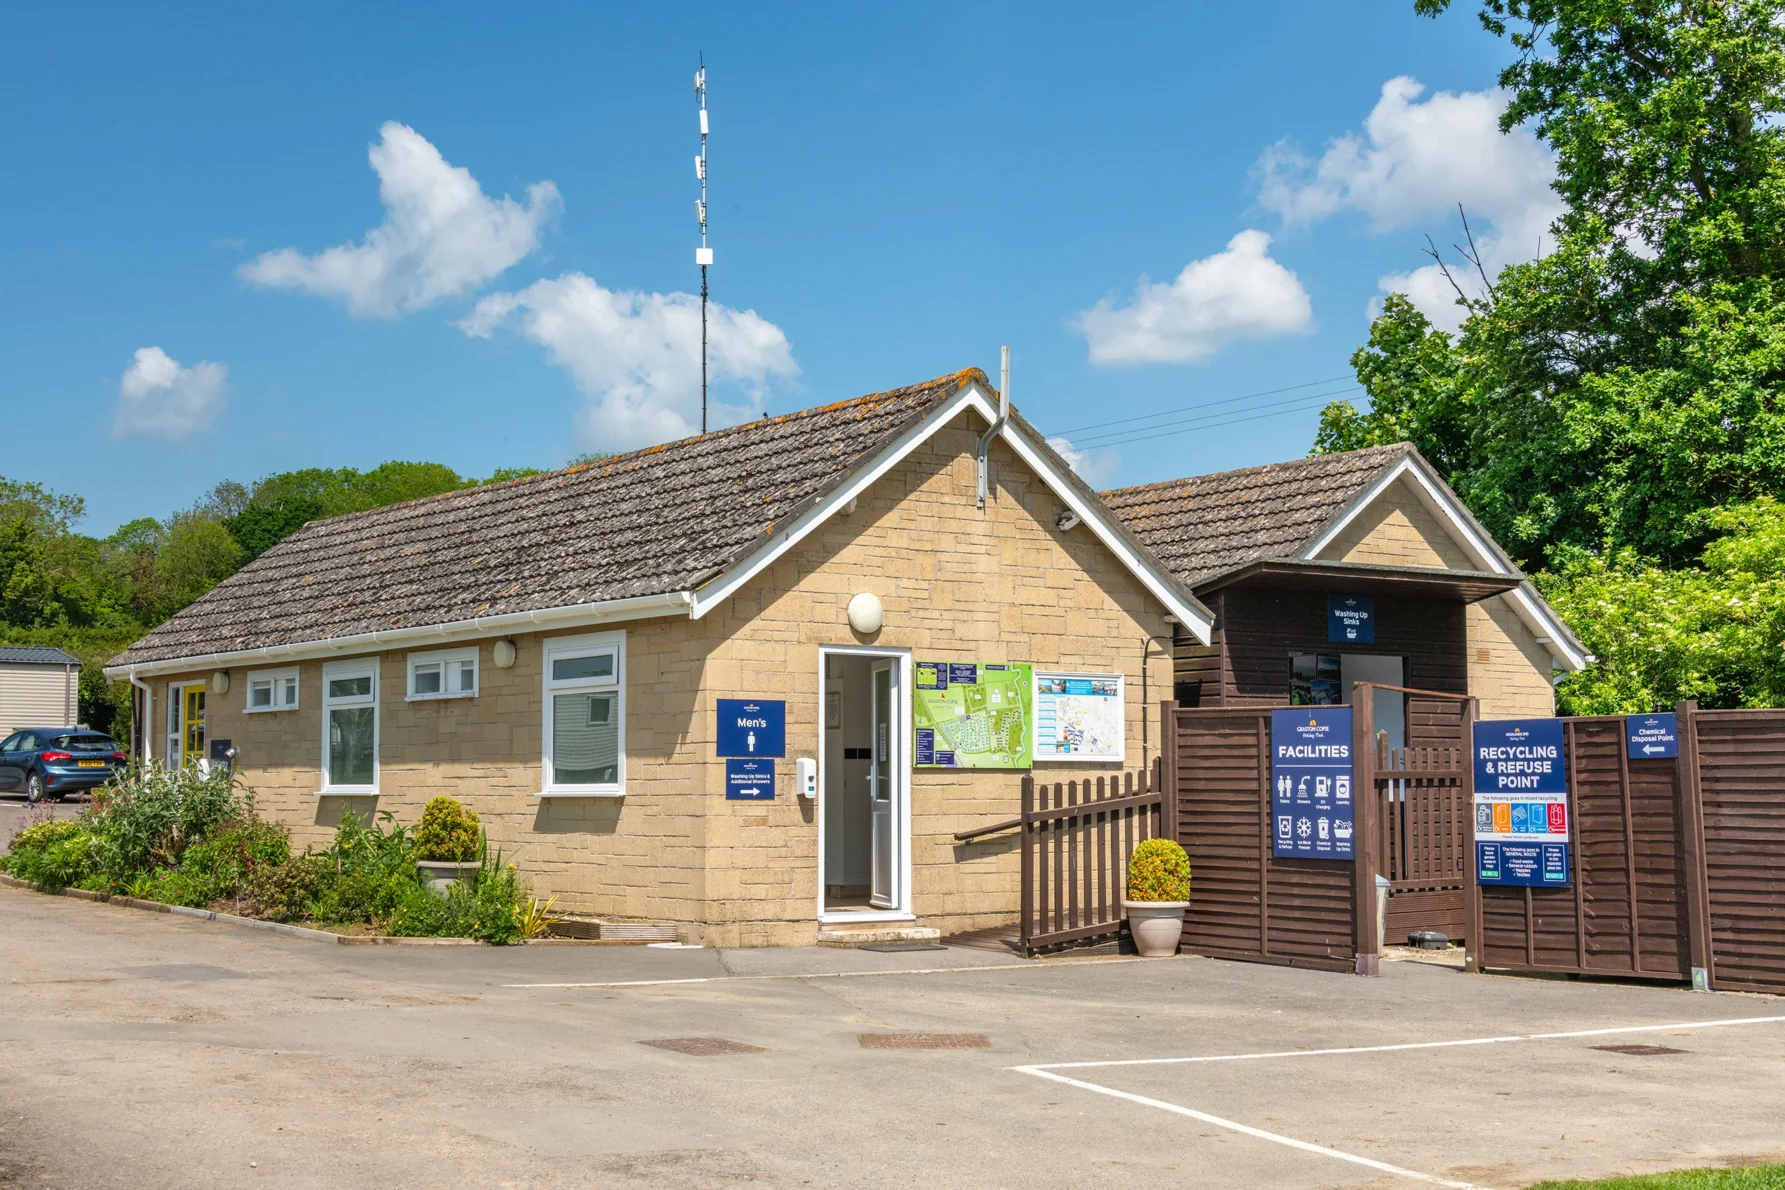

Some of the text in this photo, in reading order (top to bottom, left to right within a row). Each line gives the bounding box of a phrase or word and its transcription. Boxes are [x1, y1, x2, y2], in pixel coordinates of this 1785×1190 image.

[1334, 610, 1359, 619] Washing
[737, 718, 766, 728] Men's
[1278, 745, 1348, 758] FACILITIES
[1480, 746, 1557, 759] RECYCLING
[1486, 761, 1552, 774] & REFUSE
[1498, 776, 1540, 788] POINT
